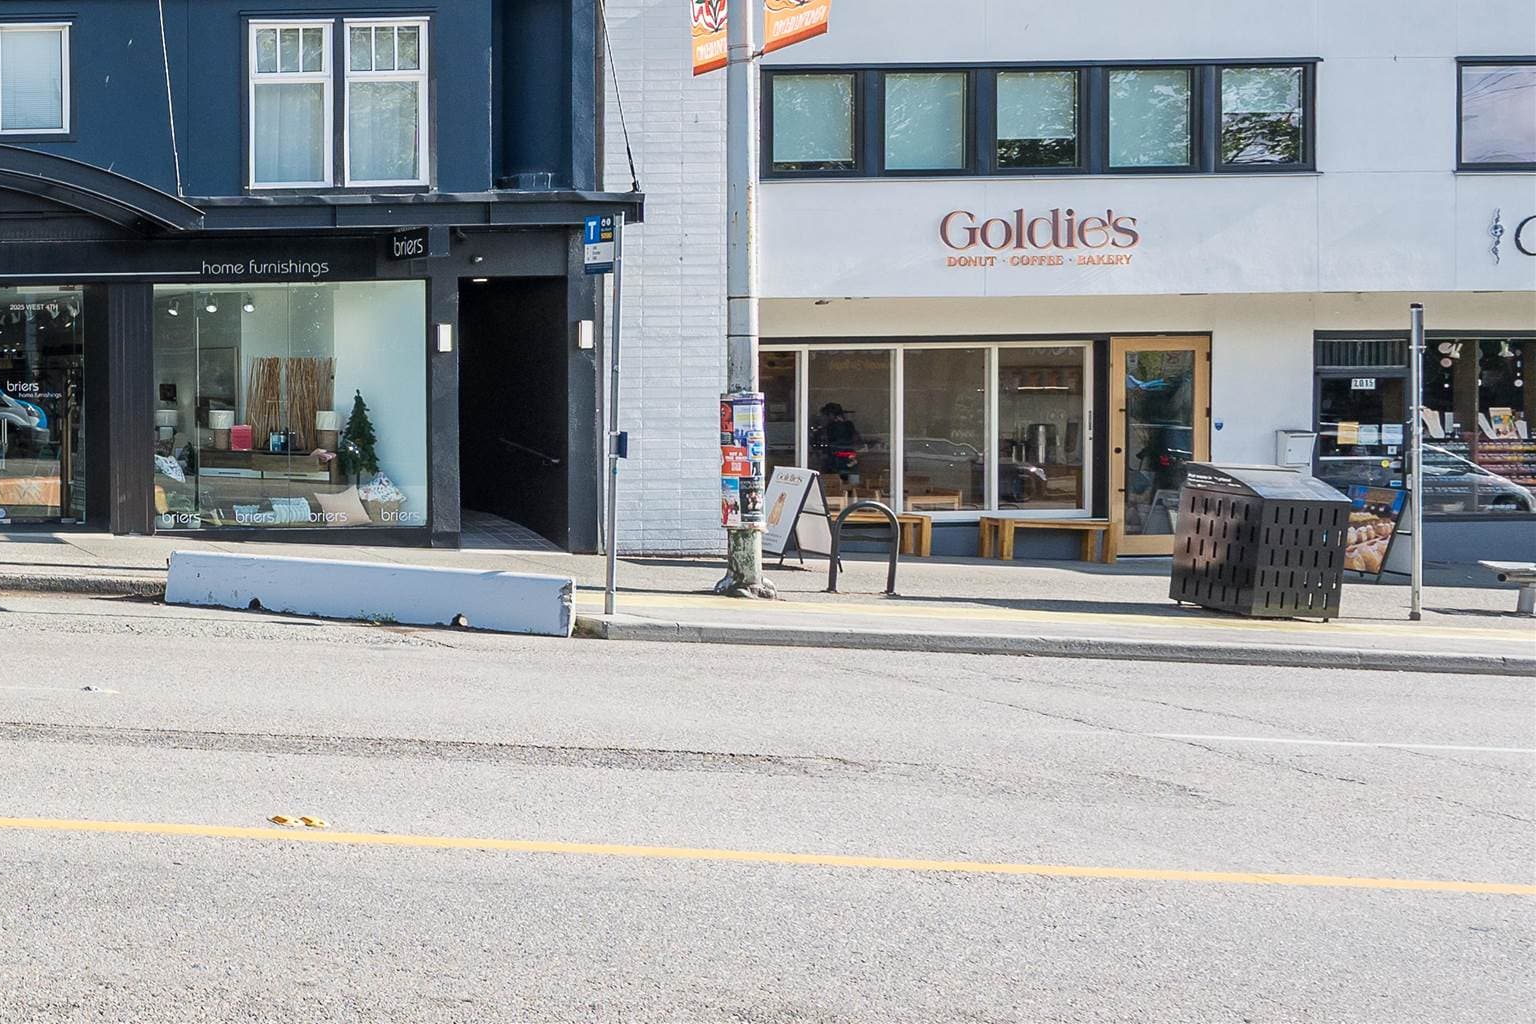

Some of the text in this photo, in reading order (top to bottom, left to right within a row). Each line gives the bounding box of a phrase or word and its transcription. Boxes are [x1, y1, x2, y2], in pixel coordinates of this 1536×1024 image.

[939, 208, 1140, 251] Goldie's
[394, 236, 423, 257] briers
[947, 254, 1133, 266] DONUT COFFEE BAKERY
[202, 259, 329, 277] home furnishings
[45, 303, 58, 311] 4TH
[6, 380, 39, 392] briers
[162, 511, 201, 524] briers
[235, 510, 275, 523] briers
[309, 509, 348, 523] briers
[381, 509, 420, 522] briers
